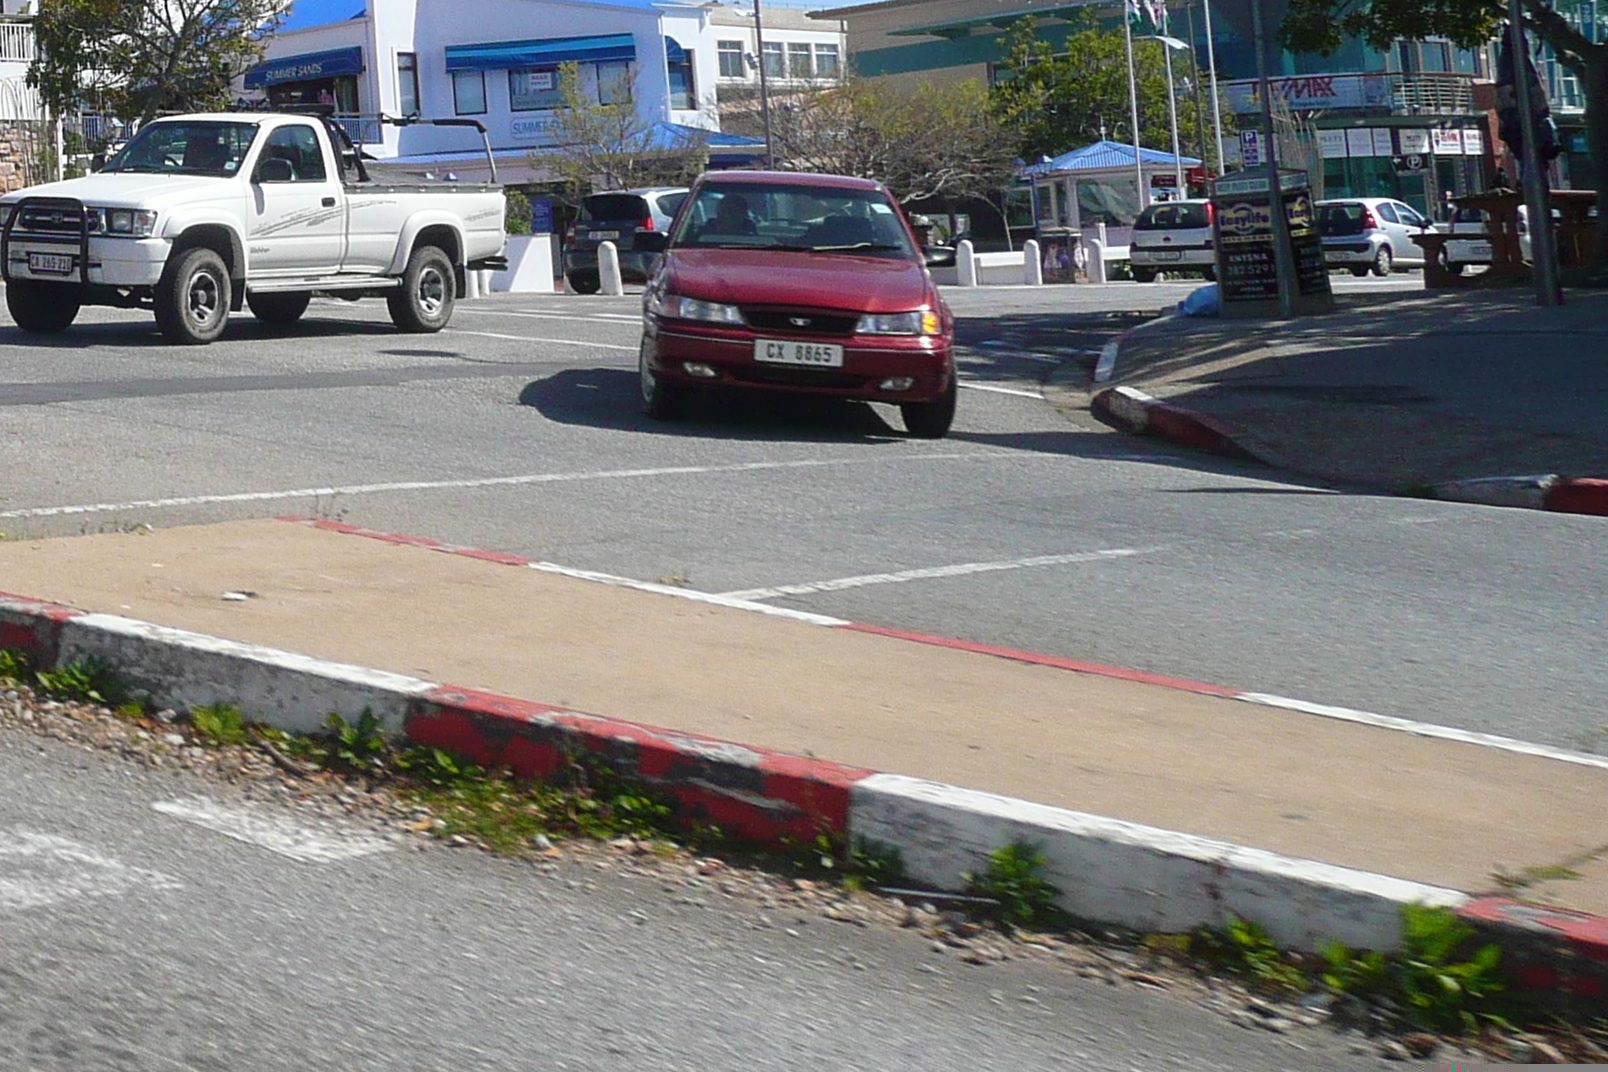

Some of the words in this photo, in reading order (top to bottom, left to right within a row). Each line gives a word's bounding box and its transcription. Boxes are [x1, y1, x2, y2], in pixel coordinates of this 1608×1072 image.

[265, 65, 296, 82] SUMMER
[297, 62, 324, 77] SANDS
[1245, 132, 1254, 143] P
[765, 342, 785, 359] CX
[795, 344, 832, 363] 8865
